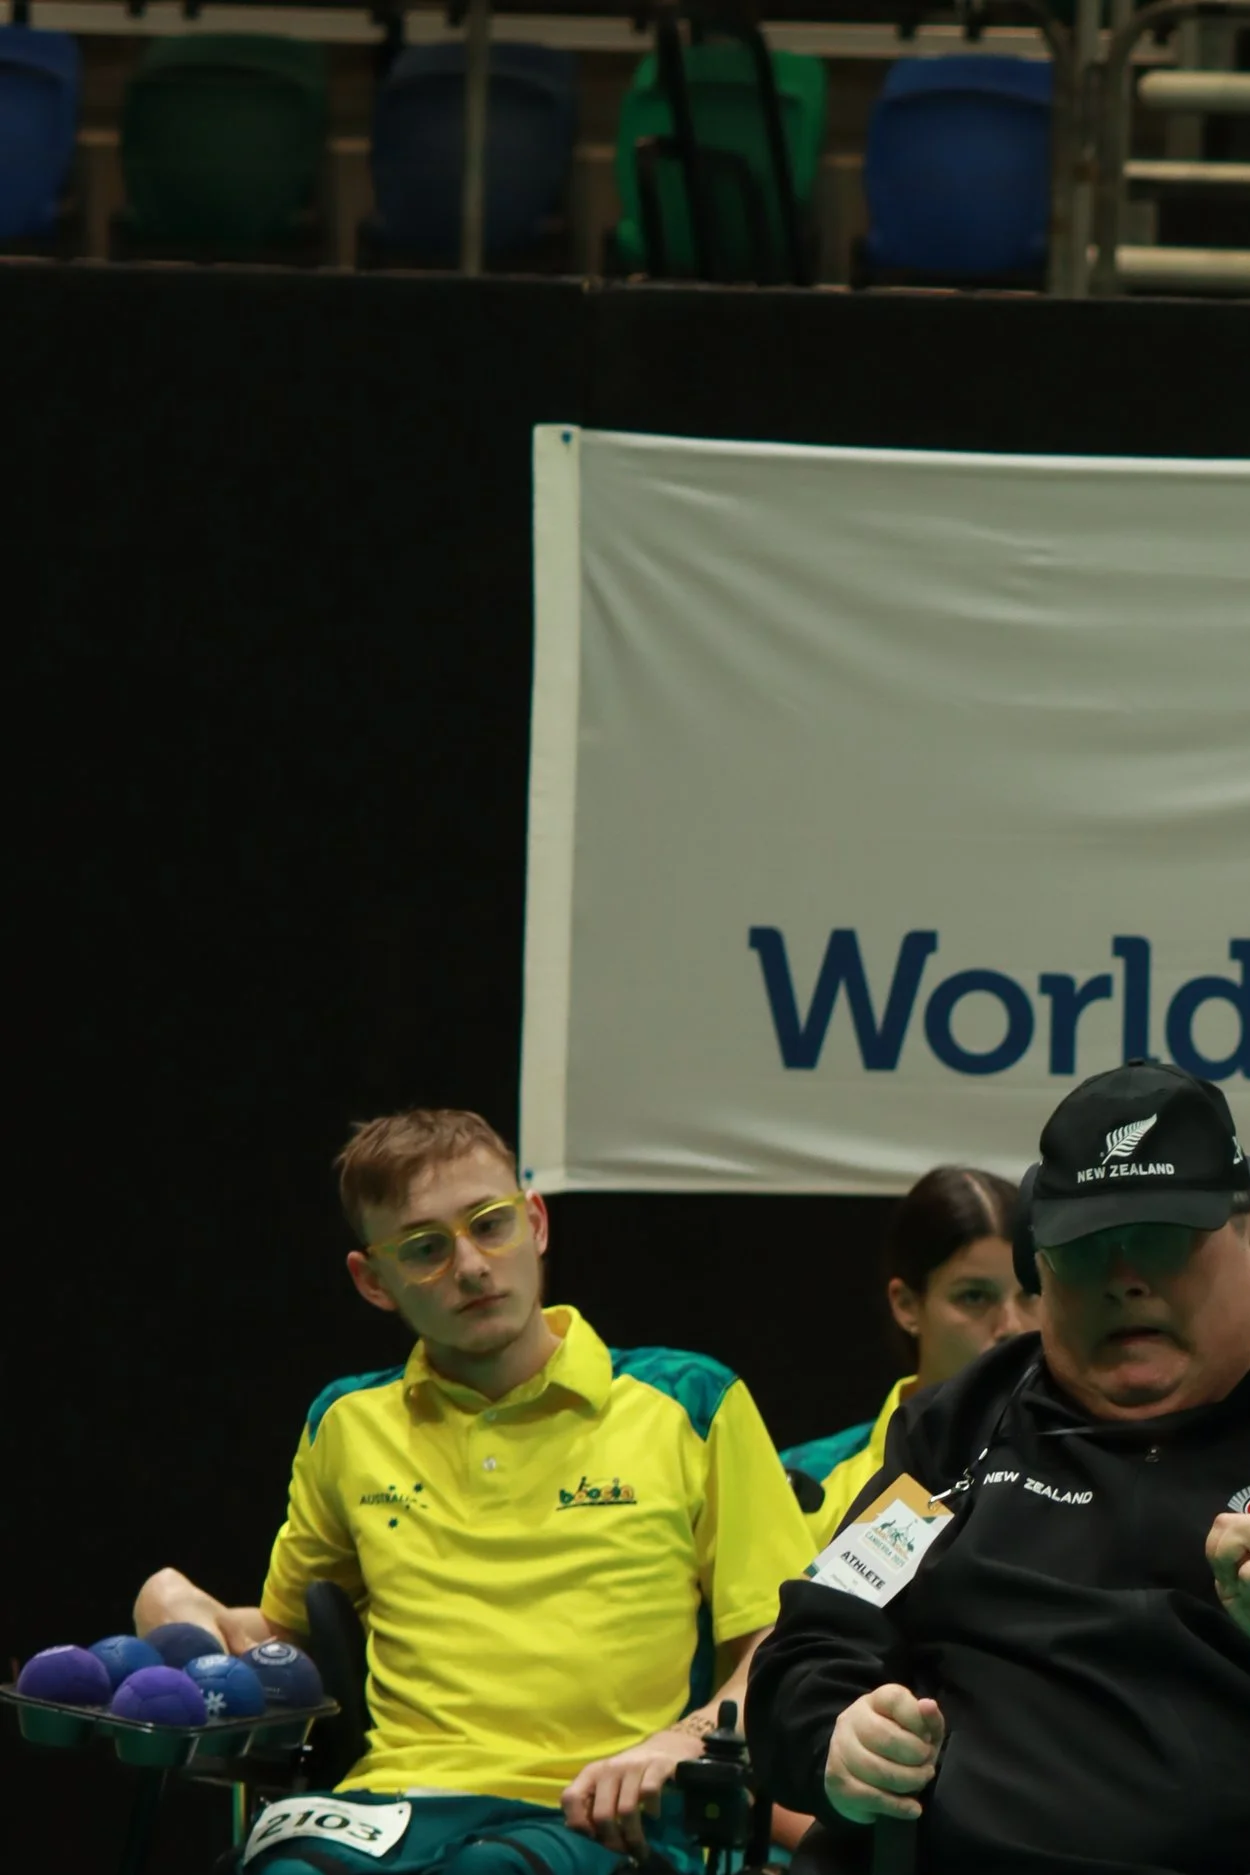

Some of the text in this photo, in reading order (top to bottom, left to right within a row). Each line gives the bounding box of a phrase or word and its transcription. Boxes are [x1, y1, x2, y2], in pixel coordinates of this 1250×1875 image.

[1077, 1162, 1175, 1184] NEW ZEALAND
[983, 1470, 1094, 1505] NEW ZEALAND
[840, 1550, 886, 1591] ATHLETE
[255, 1809, 384, 1843] 2103
